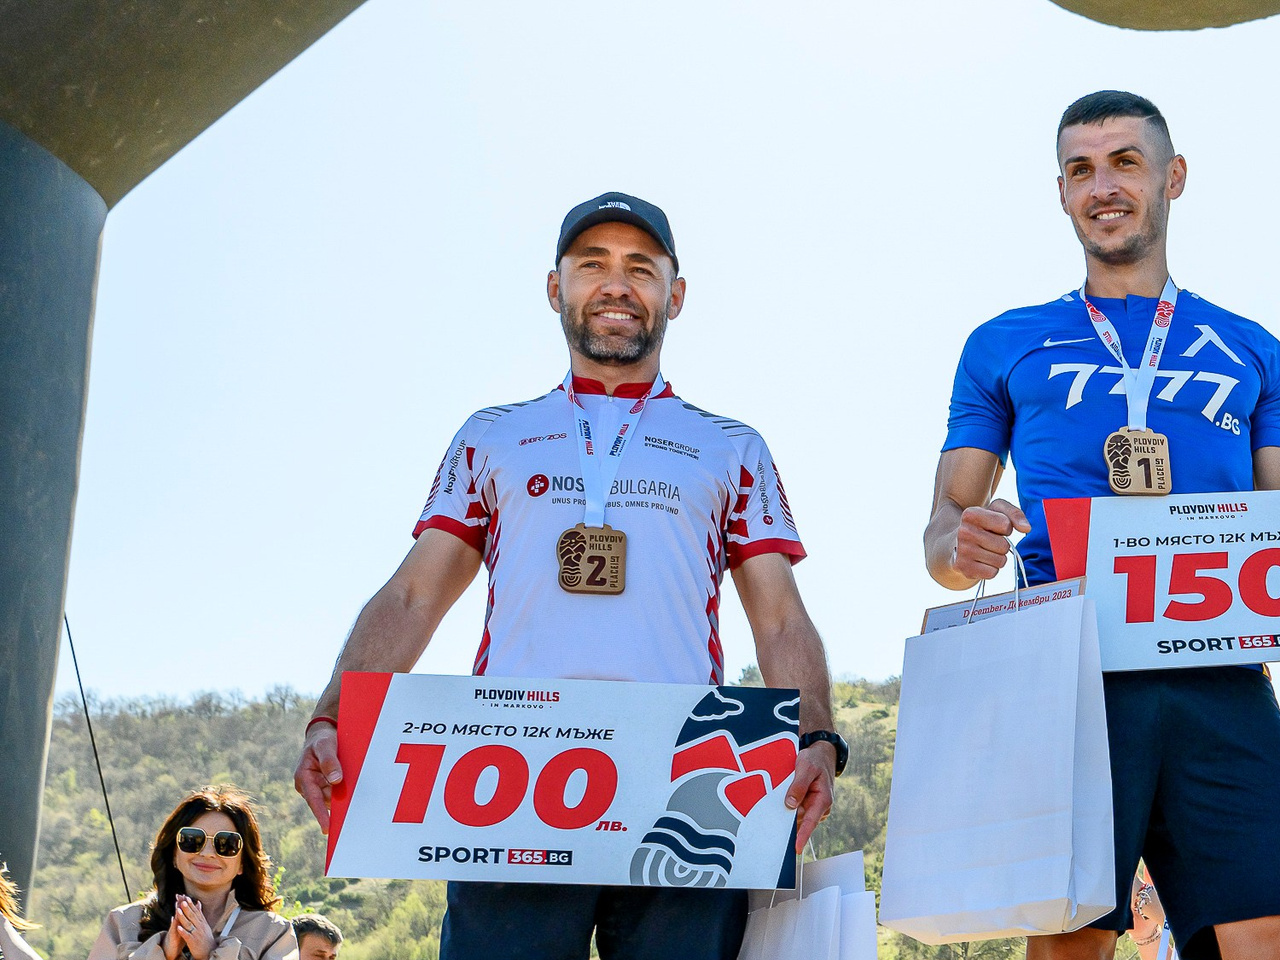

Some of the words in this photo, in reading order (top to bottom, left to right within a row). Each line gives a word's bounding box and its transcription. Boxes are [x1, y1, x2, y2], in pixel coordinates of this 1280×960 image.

[644, 435, 700, 455] NOSERGROUP
[1133, 437, 1165, 446] PLOVDIV
[1134, 446, 1156, 454] HILLS
[1137, 457, 1153, 489] 1
[552, 475, 585, 492] NOS
[610, 479, 681, 502] BULGARIA
[552, 497, 571, 505] UNUS
[625, 500, 649, 509] OMNES
[651, 502, 665, 511] PRO
[665, 506, 679, 516] UNO
[1169, 503, 1215, 515] PLOVDIV
[1217, 502, 1248, 513] HILLS
[589, 534, 624, 543] PLOVDIV
[589, 543, 613, 551] HILLS
[1113, 537, 1151, 548] 1-ВО
[1155, 533, 1215, 547] МЯСТО
[586, 555, 607, 586] 2
[963, 603, 1004, 618] Dcember
[1052, 589, 1072, 601] 2023
[1157, 637, 1236, 654] SPORT
[474, 688, 526, 701] PLOVDIV
[527, 690, 560, 702] HILLS
[403, 722, 447, 735] 2-РО
[451, 723, 518, 737] МЯСТО
[555, 727, 615, 741] МЪЖЕ
[392, 742, 618, 830] 100
[418, 845, 505, 864] SPORT
[510, 850, 569, 864] 365.BG
